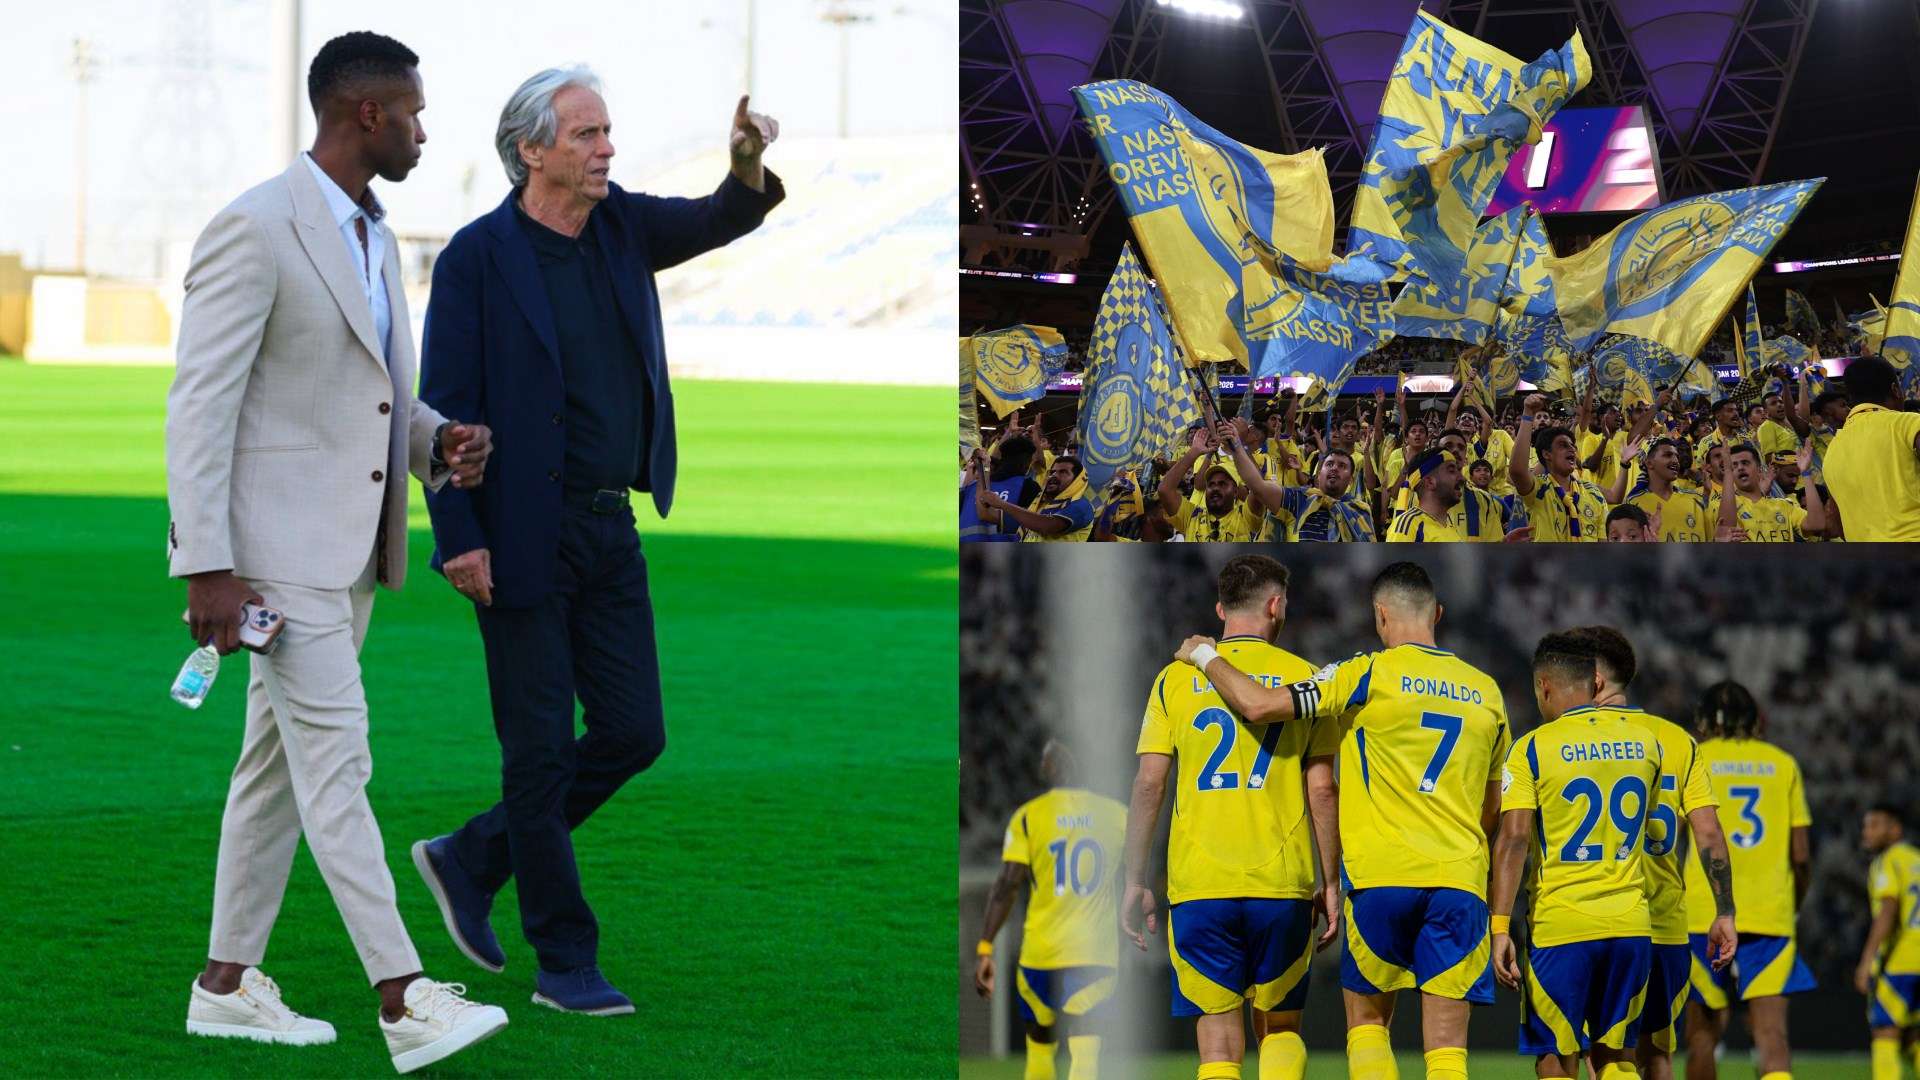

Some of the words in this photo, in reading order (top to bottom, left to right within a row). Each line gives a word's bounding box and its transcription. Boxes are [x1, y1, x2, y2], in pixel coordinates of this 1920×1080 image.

[1193, 674, 1282, 695] LATE
[1402, 676, 1482, 705] RONALDO
[1192, 707, 1284, 792] 27
[1417, 711, 1465, 793] 7
[1561, 741, 1645, 762] GHAREEB
[1560, 774, 1648, 862] 29
[1727, 785, 1766, 848] 3
[1049, 837, 1104, 897] 10
